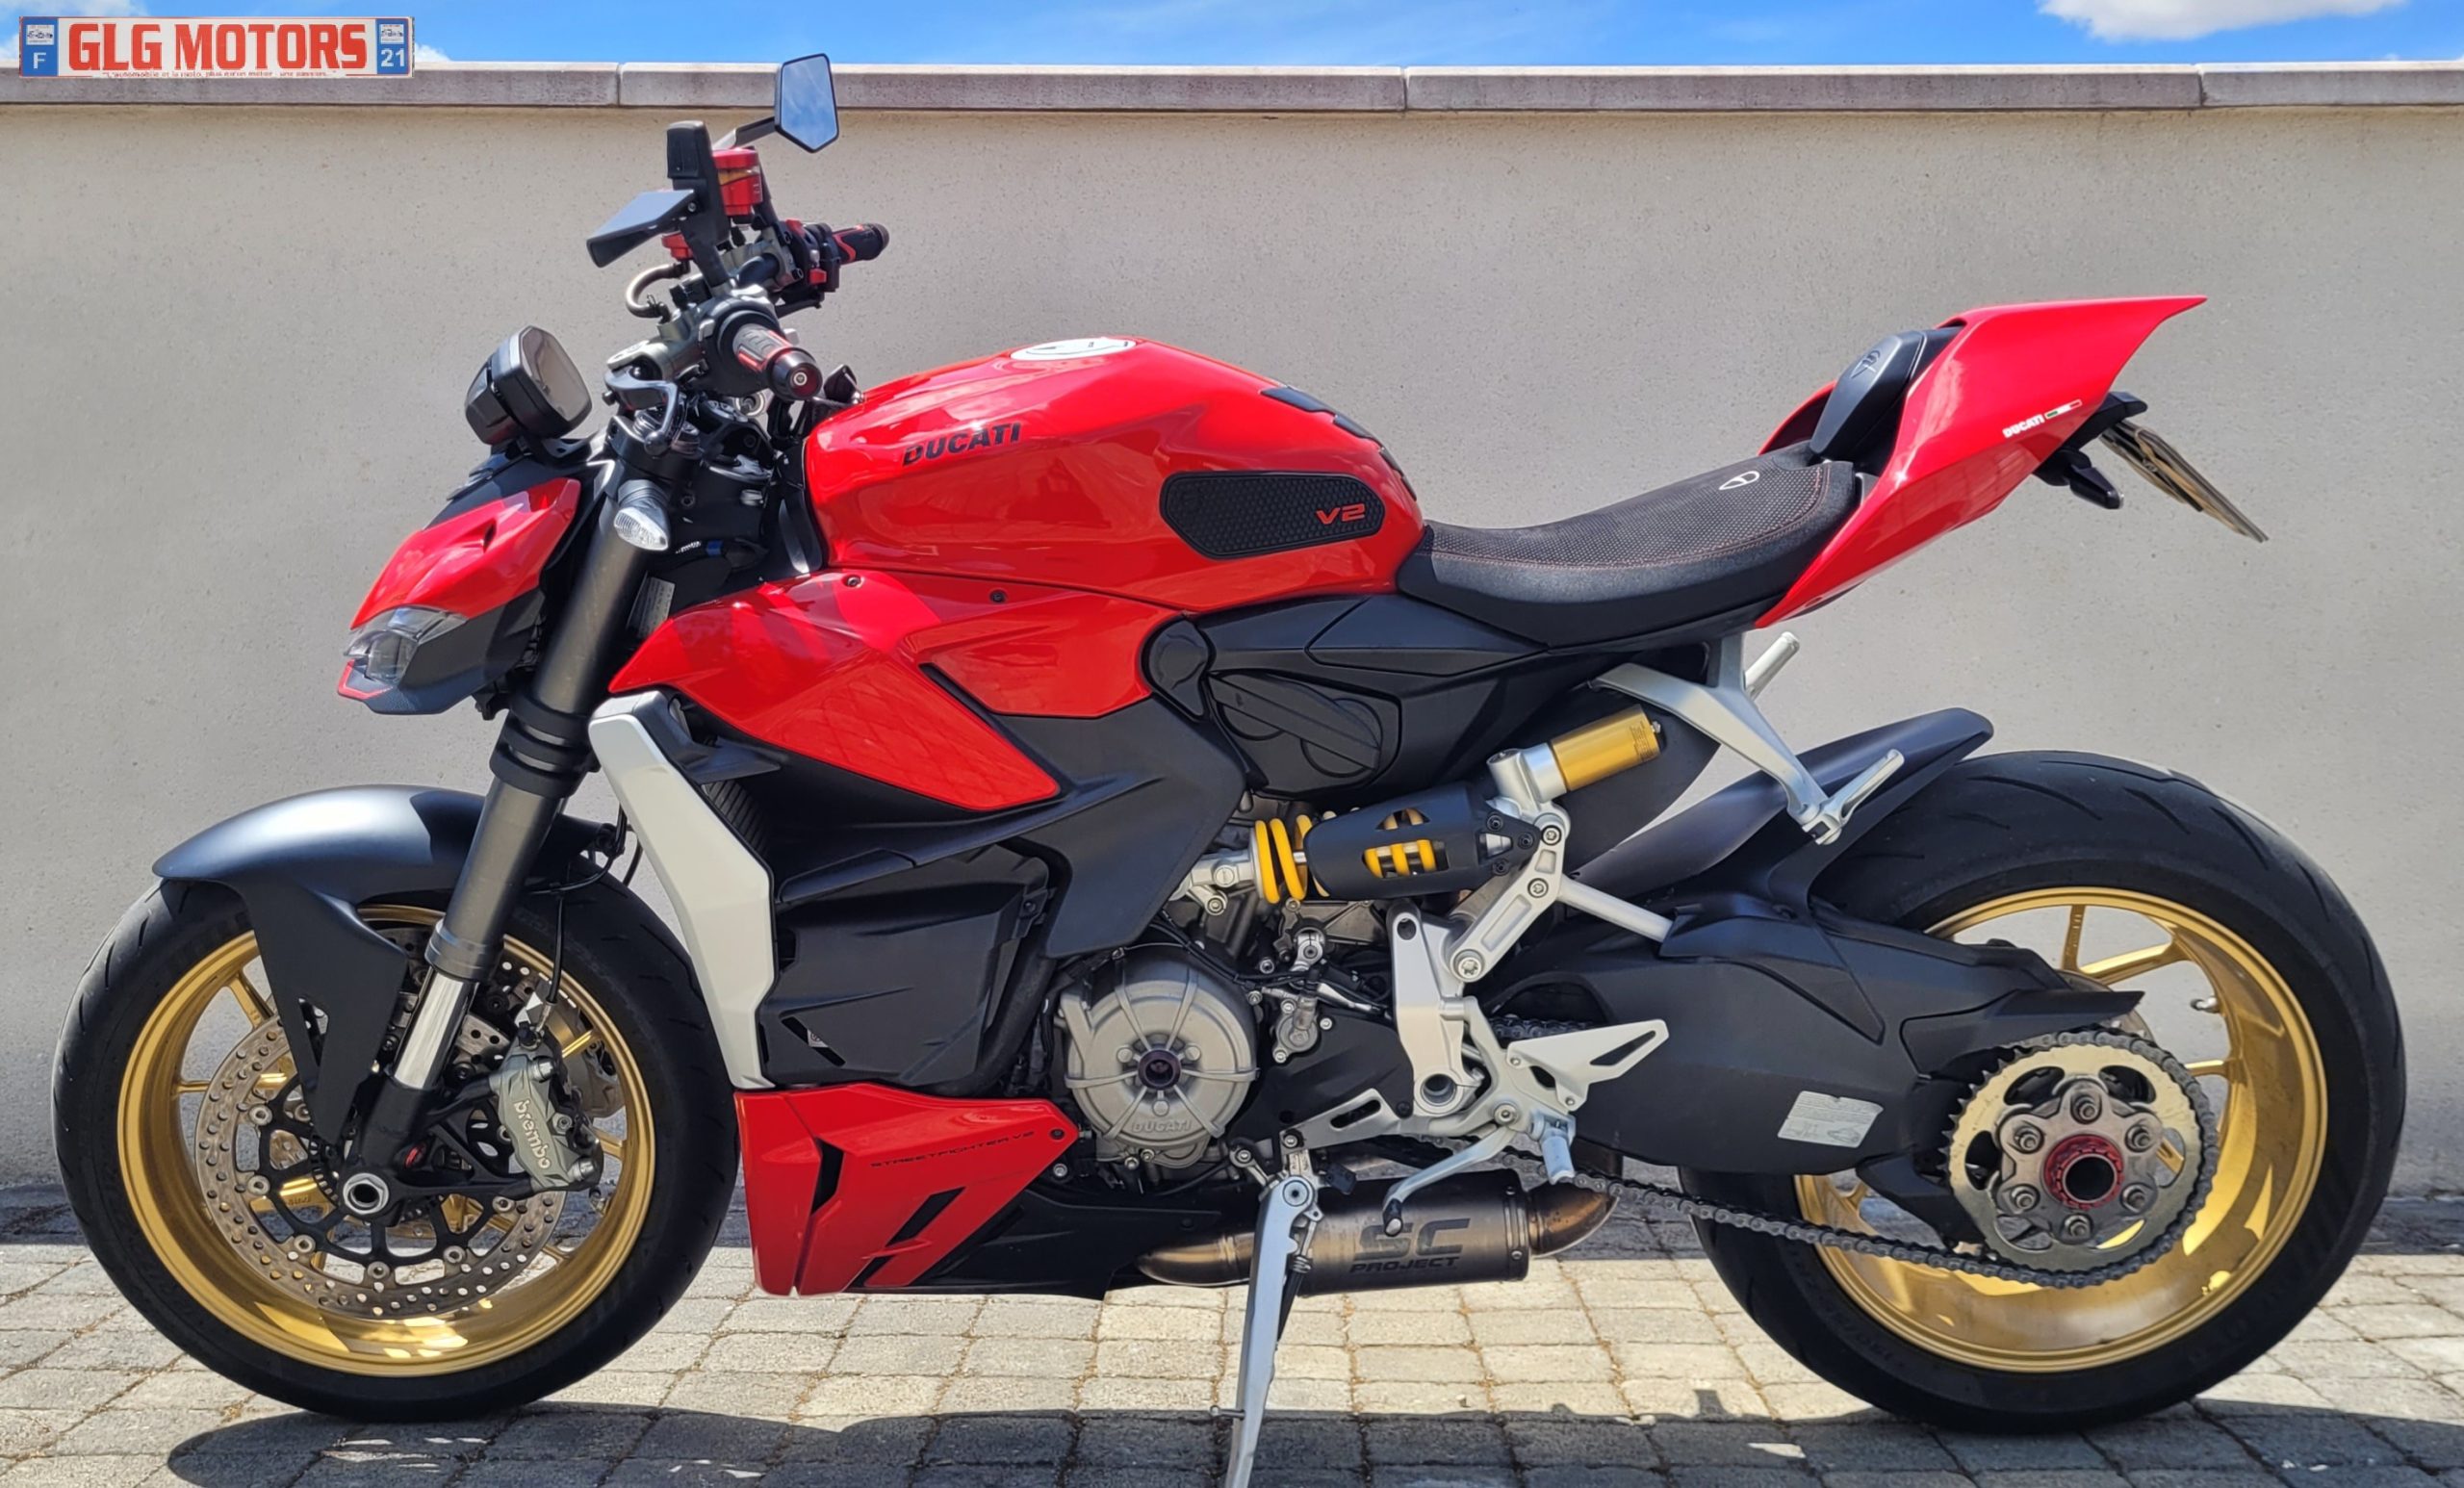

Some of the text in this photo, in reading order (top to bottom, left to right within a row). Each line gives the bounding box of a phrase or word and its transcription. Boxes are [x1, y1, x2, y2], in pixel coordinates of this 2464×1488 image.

[2002, 413, 2045, 438] DUCATI
[902, 422, 1021, 467] DUCATI
[1315, 502, 1366, 525] V2
[513, 1099, 551, 1169] brembo
[1131, 1119, 1193, 1134] DUCATI
[1352, 1218, 1471, 1261] SC
[1348, 1256, 1461, 1273] PROJECT
